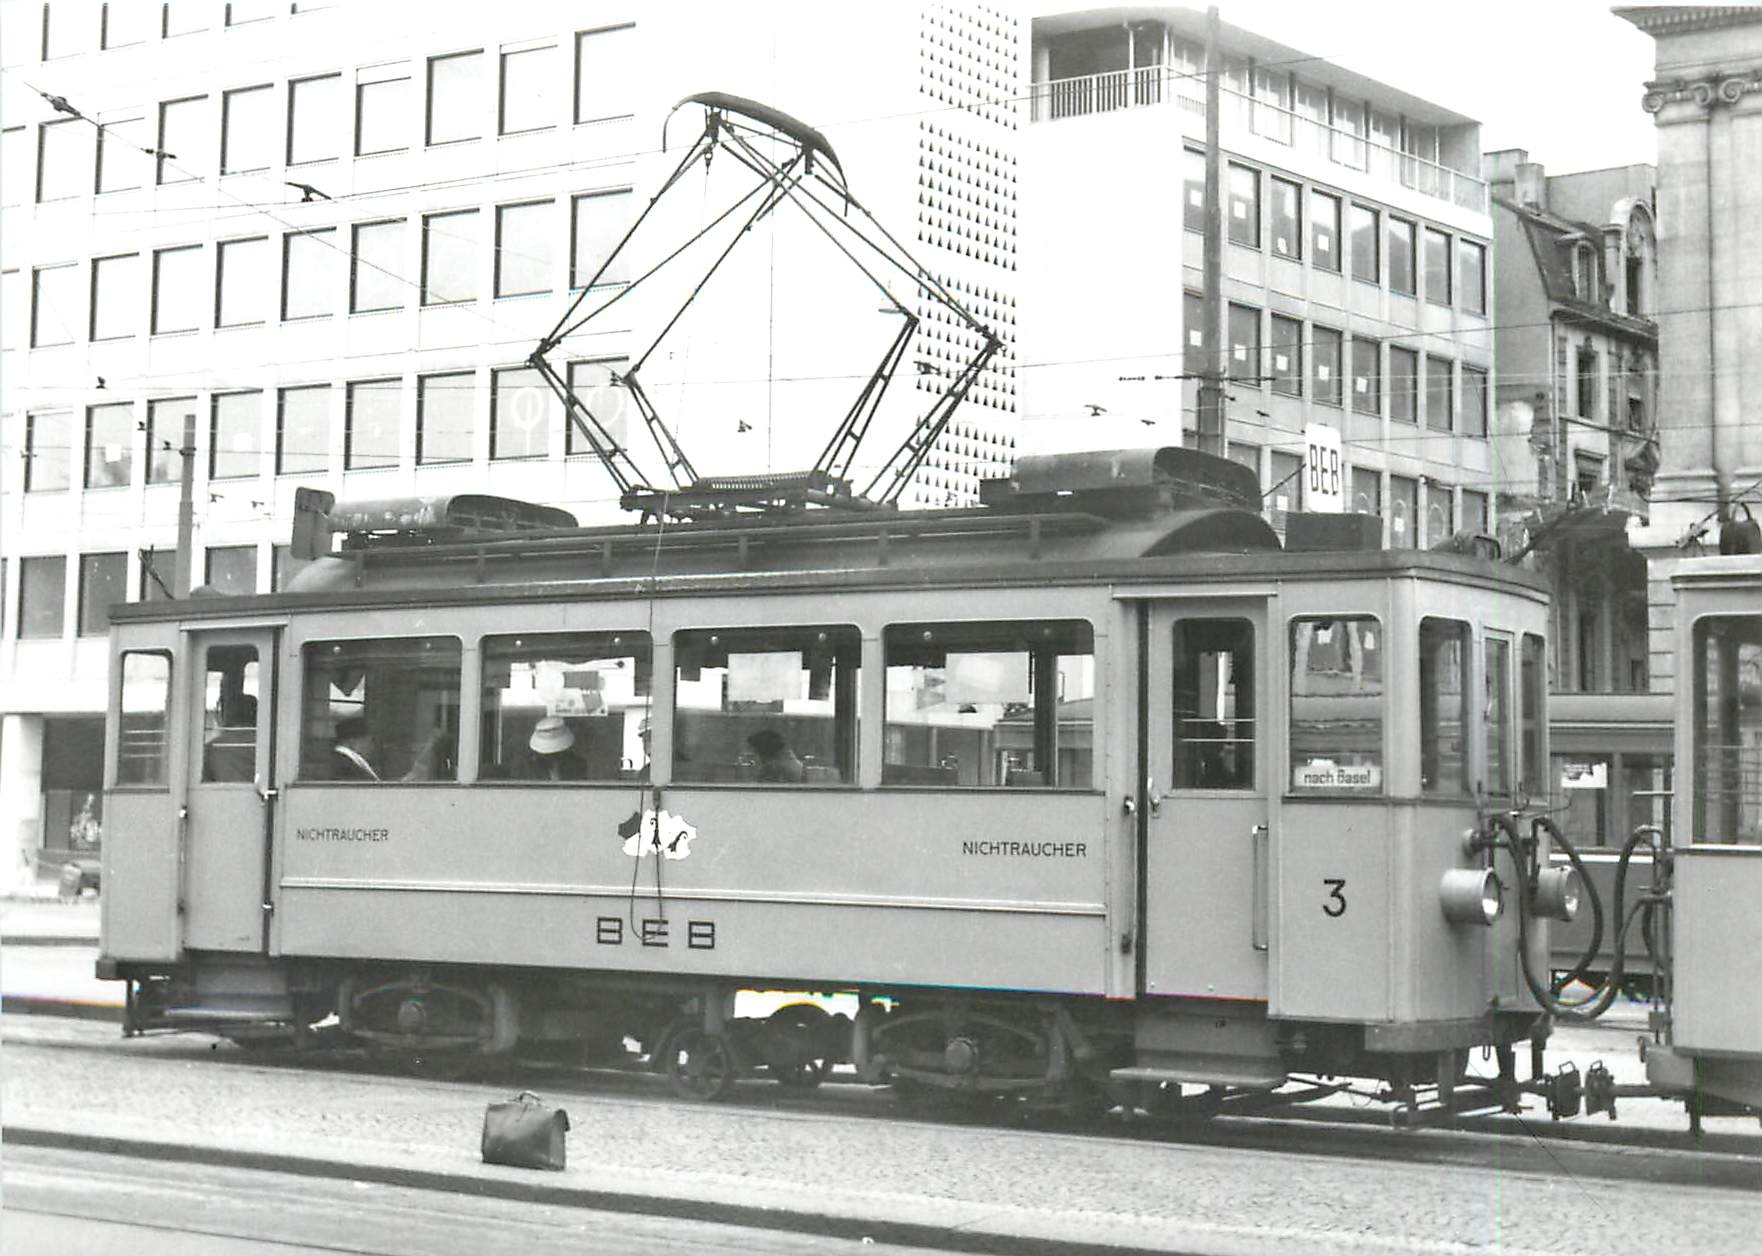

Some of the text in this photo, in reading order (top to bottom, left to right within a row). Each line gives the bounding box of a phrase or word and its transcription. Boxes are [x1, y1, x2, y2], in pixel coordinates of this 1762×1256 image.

[1309, 443, 1339, 496] BEB
[1304, 768, 1371, 785] nach Basel
[296, 828, 389, 842] NICHTRAUCHER
[962, 841, 1087, 858] NICHTRAUCHER
[1322, 879, 1347, 918] 3
